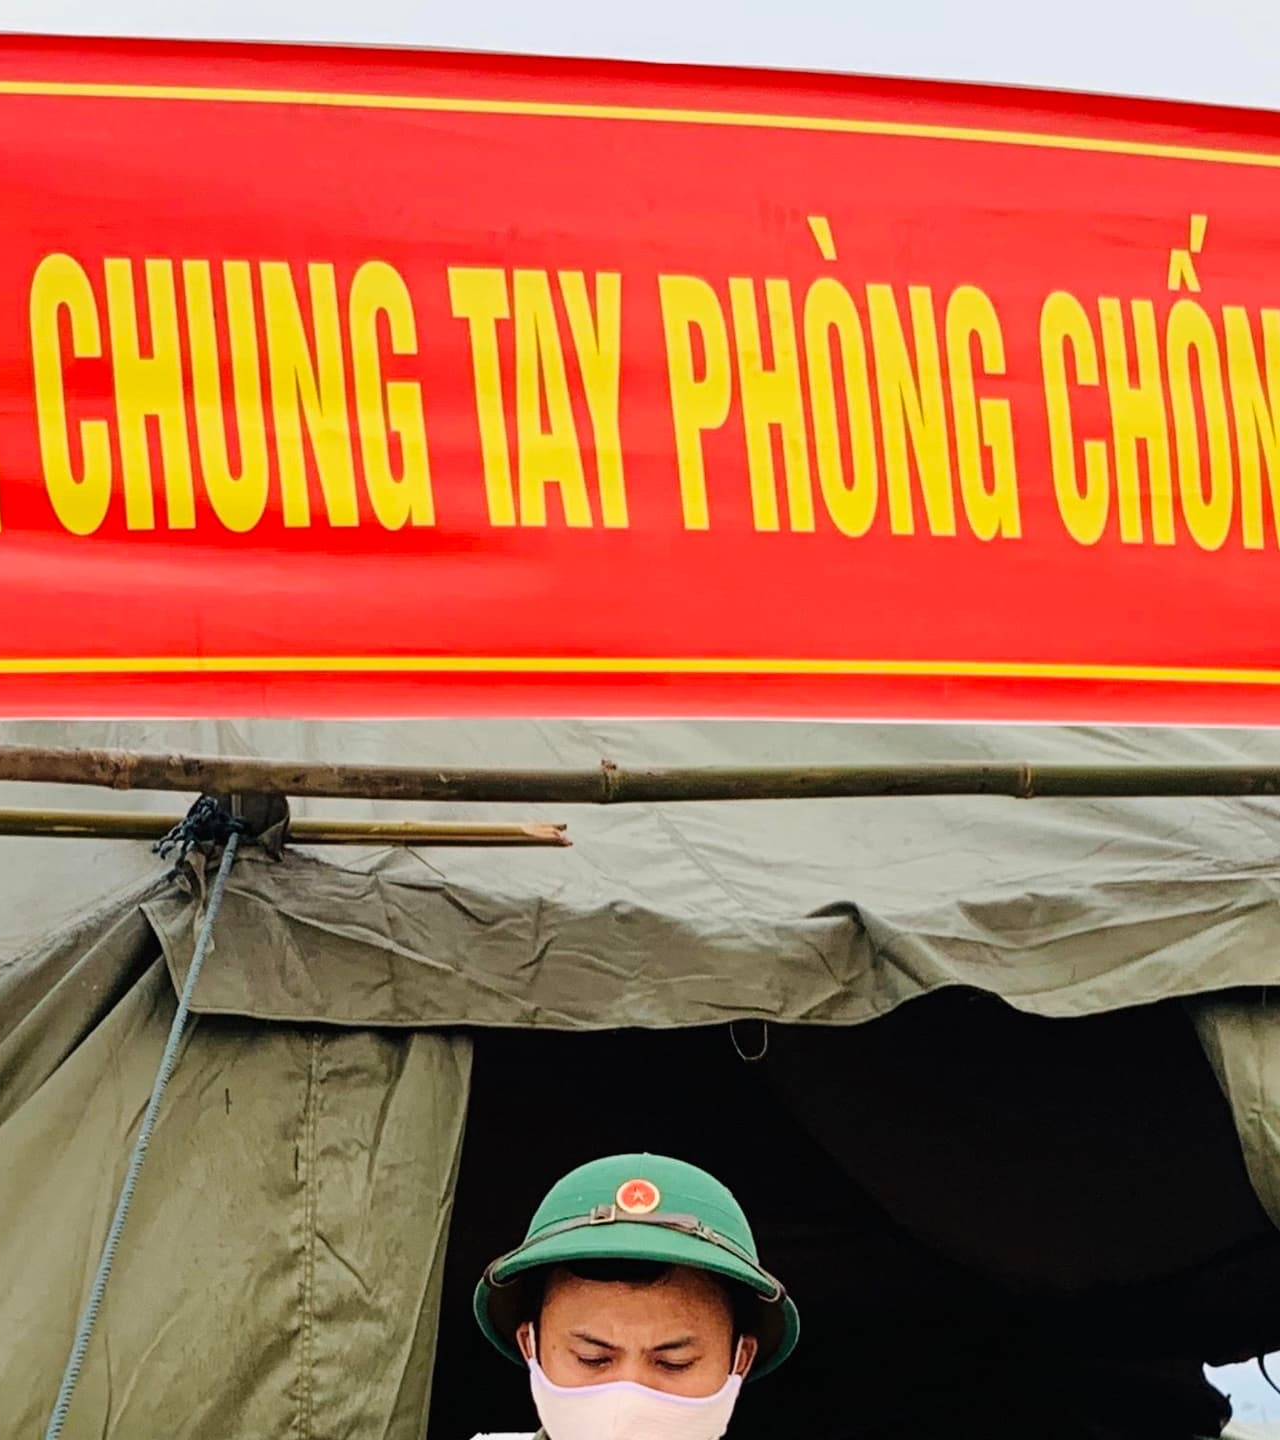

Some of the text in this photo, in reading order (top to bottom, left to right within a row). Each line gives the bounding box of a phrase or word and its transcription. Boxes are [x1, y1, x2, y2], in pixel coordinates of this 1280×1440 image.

[29, 252, 435, 534] CHUNG
[448, 266, 629, 529] TAY
[657, 215, 1021, 541] PHÒNG
